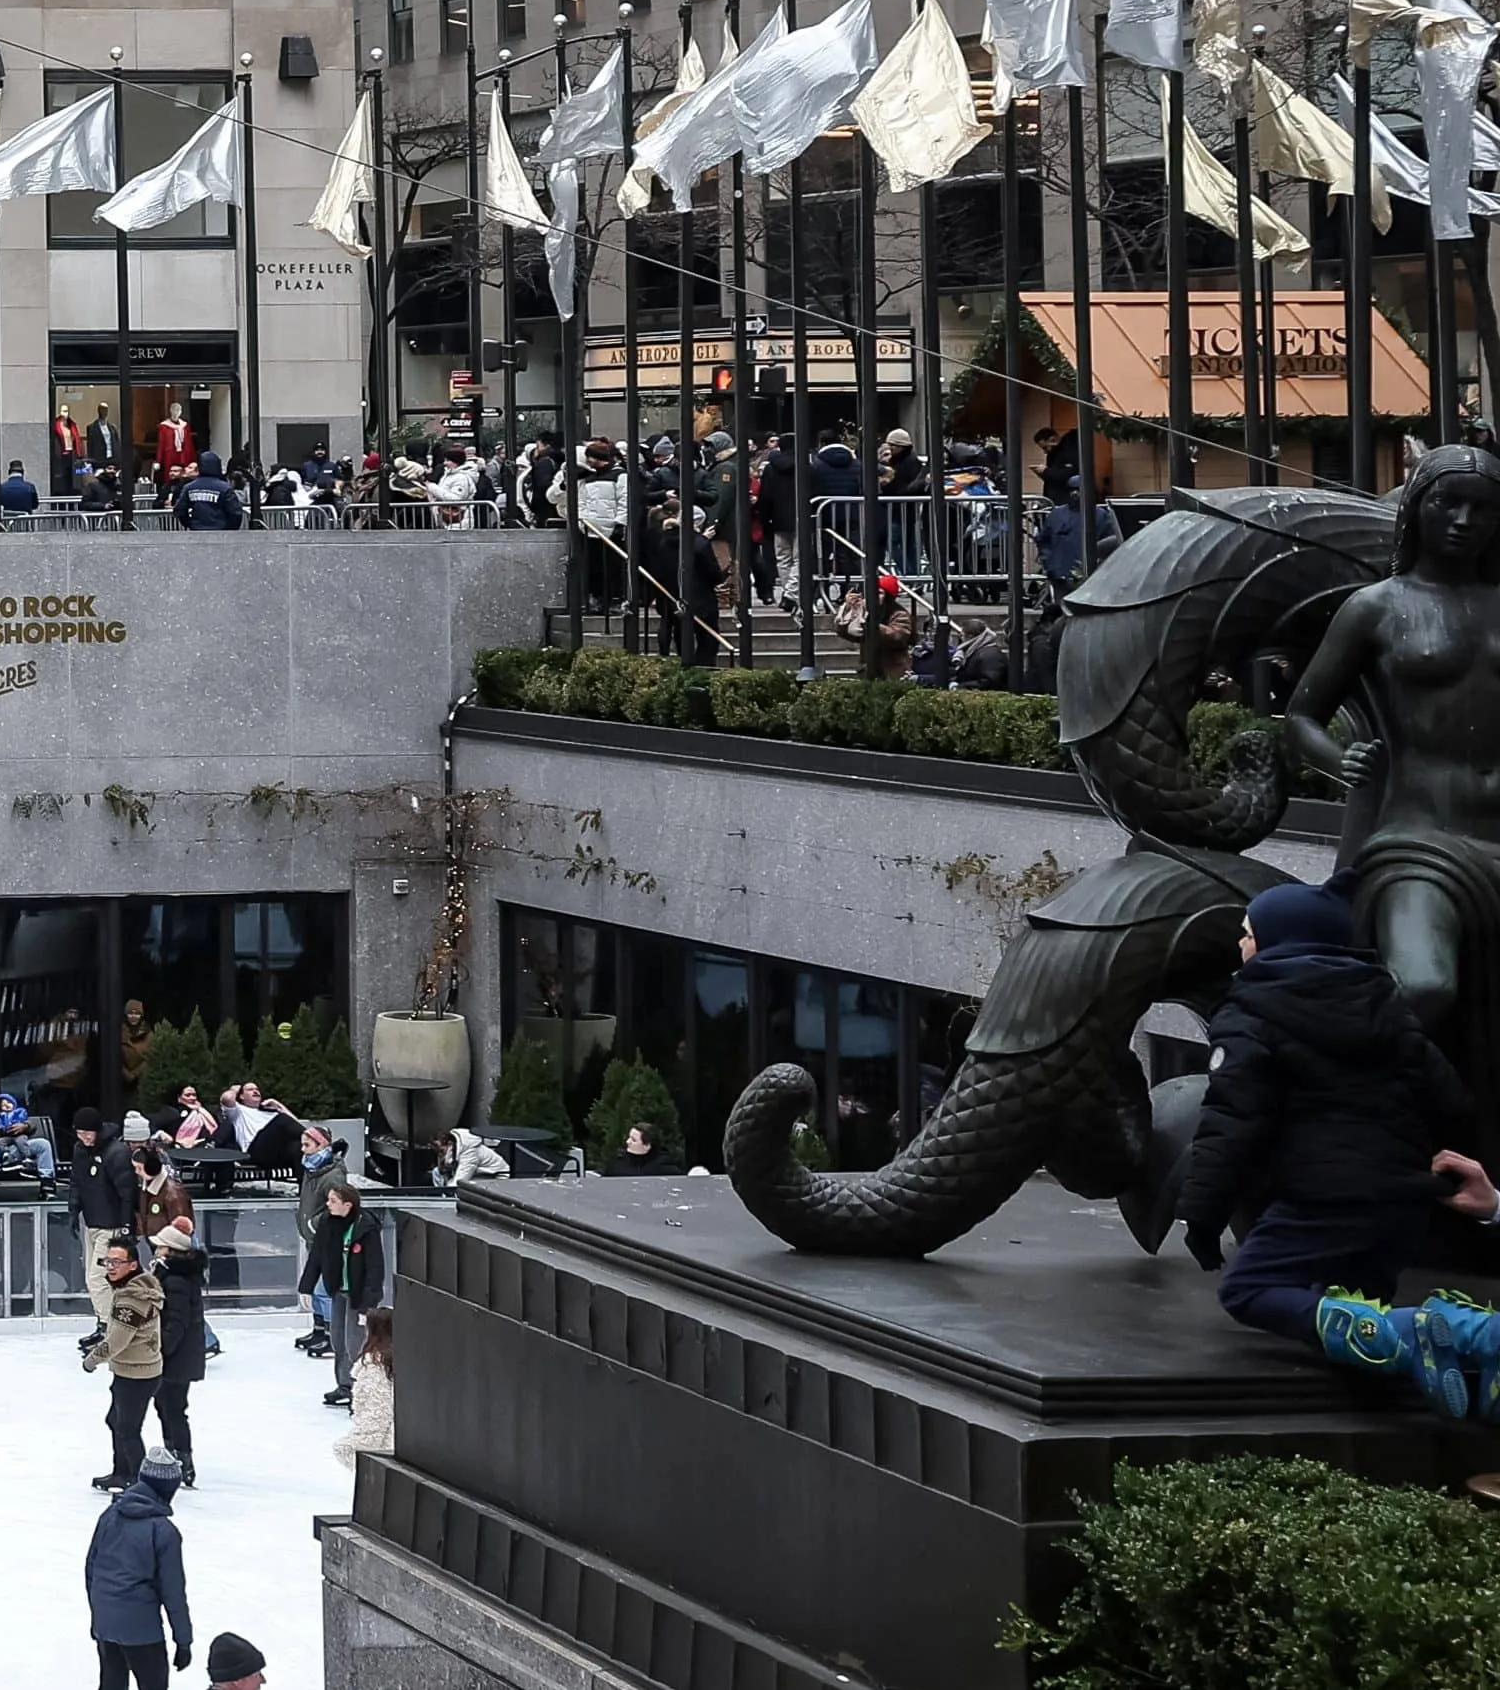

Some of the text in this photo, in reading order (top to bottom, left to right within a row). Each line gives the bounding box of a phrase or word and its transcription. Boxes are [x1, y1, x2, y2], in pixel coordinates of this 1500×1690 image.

[256, 263, 354, 274] OCKEFELLER
[275, 279, 325, 290] PLAZA
[1164, 327, 1348, 356] ICETS
[610, 344, 720, 364] ANHROPOGIE
[766, 344, 908, 356] ANROPOGIE
[23, 595, 97, 618] ROCK
